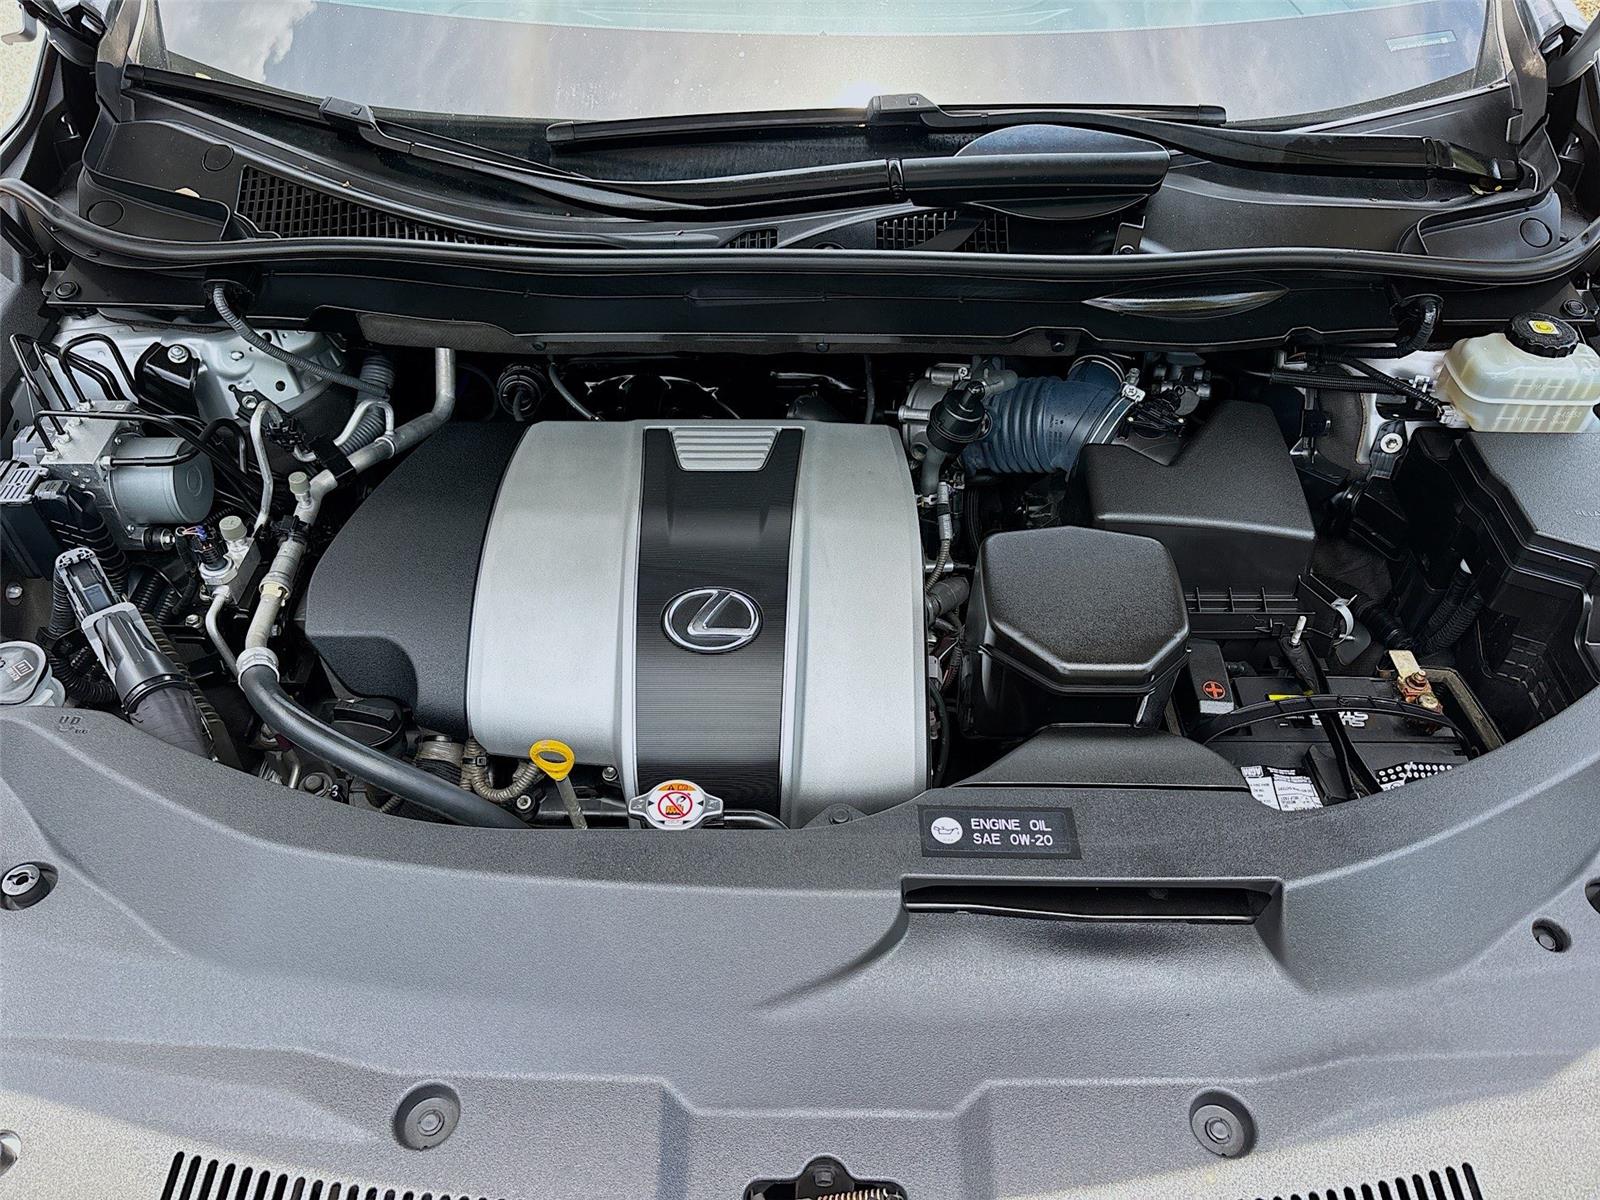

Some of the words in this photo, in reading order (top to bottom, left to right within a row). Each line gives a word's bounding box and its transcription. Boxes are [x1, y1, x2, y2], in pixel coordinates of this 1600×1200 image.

[970, 818, 1020, 831] ENGINE
[1029, 819, 1052, 832] OIL
[973, 833, 1001, 845] SAE
[1010, 834, 1053, 846] 0W-20
